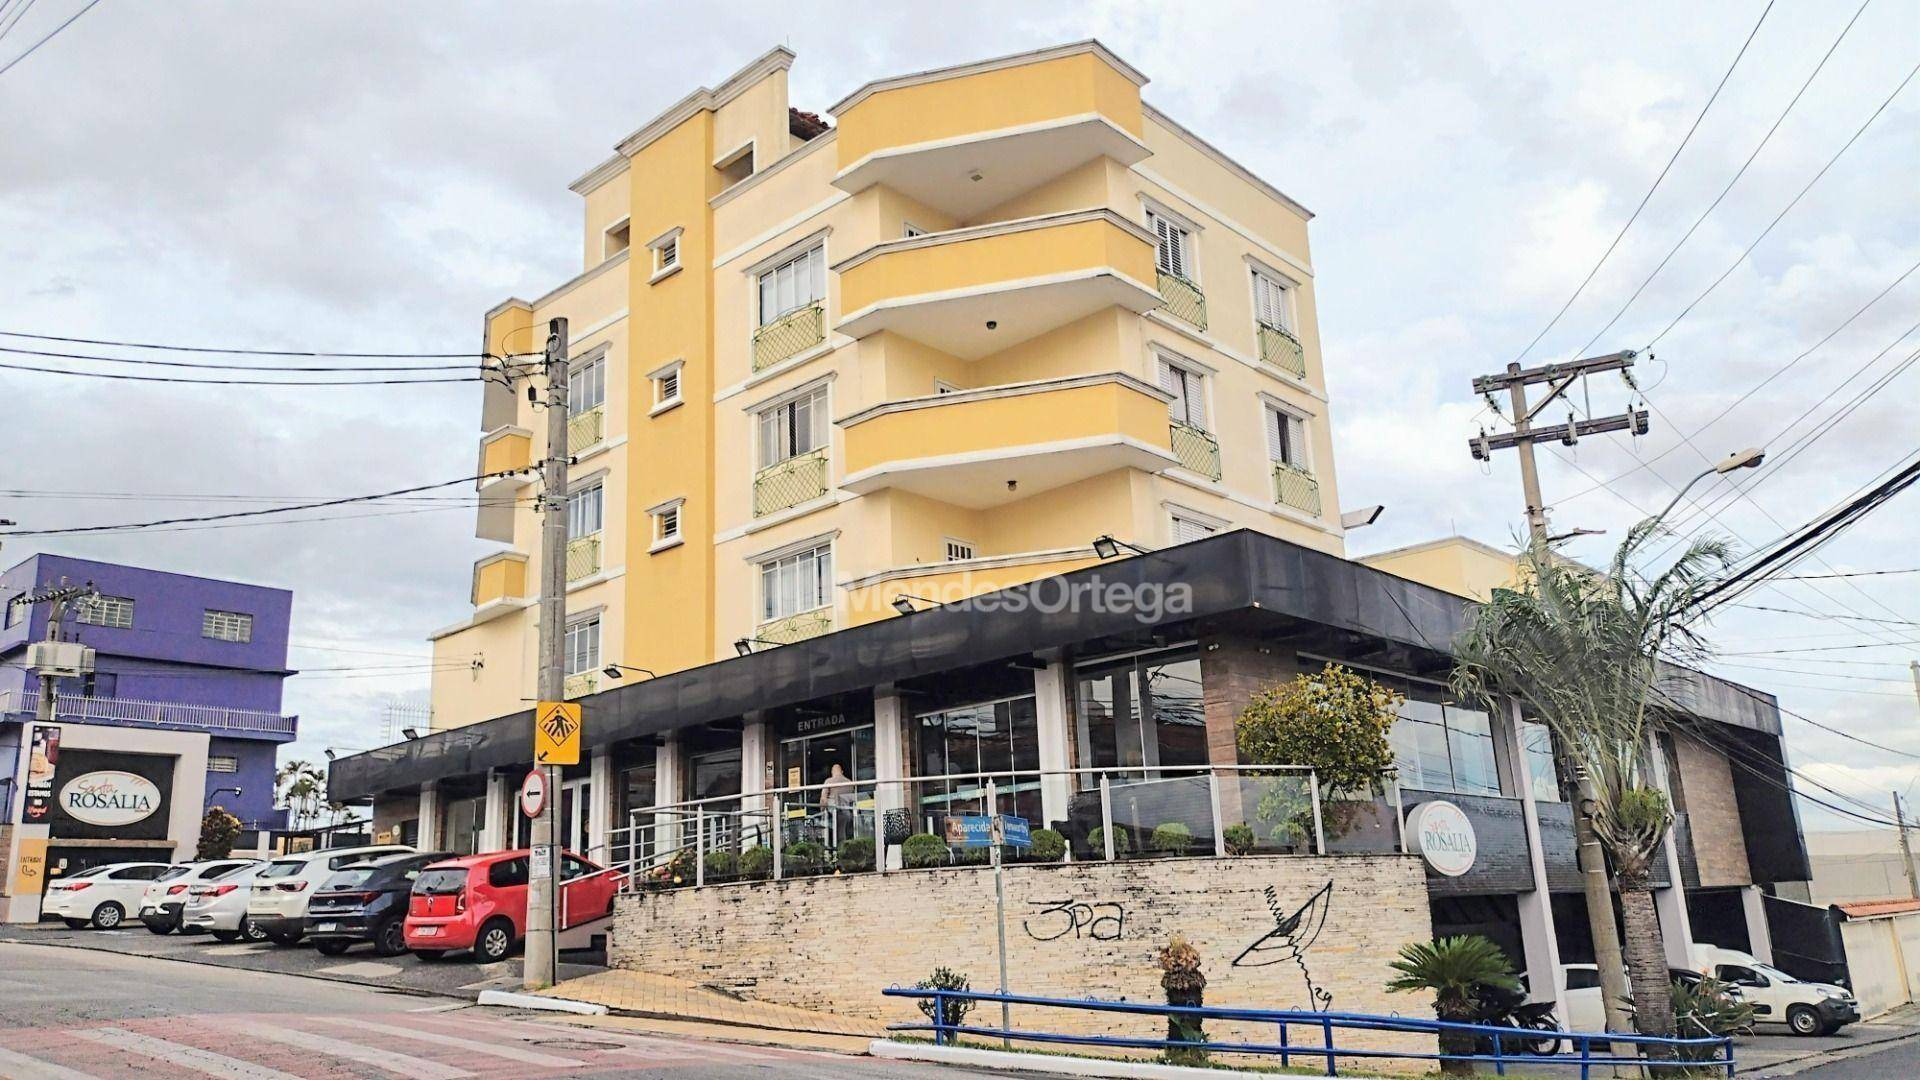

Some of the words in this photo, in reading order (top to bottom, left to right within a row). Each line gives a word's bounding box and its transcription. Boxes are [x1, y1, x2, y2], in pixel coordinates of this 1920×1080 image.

[797, 713, 846, 732] ENTRADA
[69, 789, 151, 809] ROSÁLIA
[951, 821, 991, 836] Aparecida
